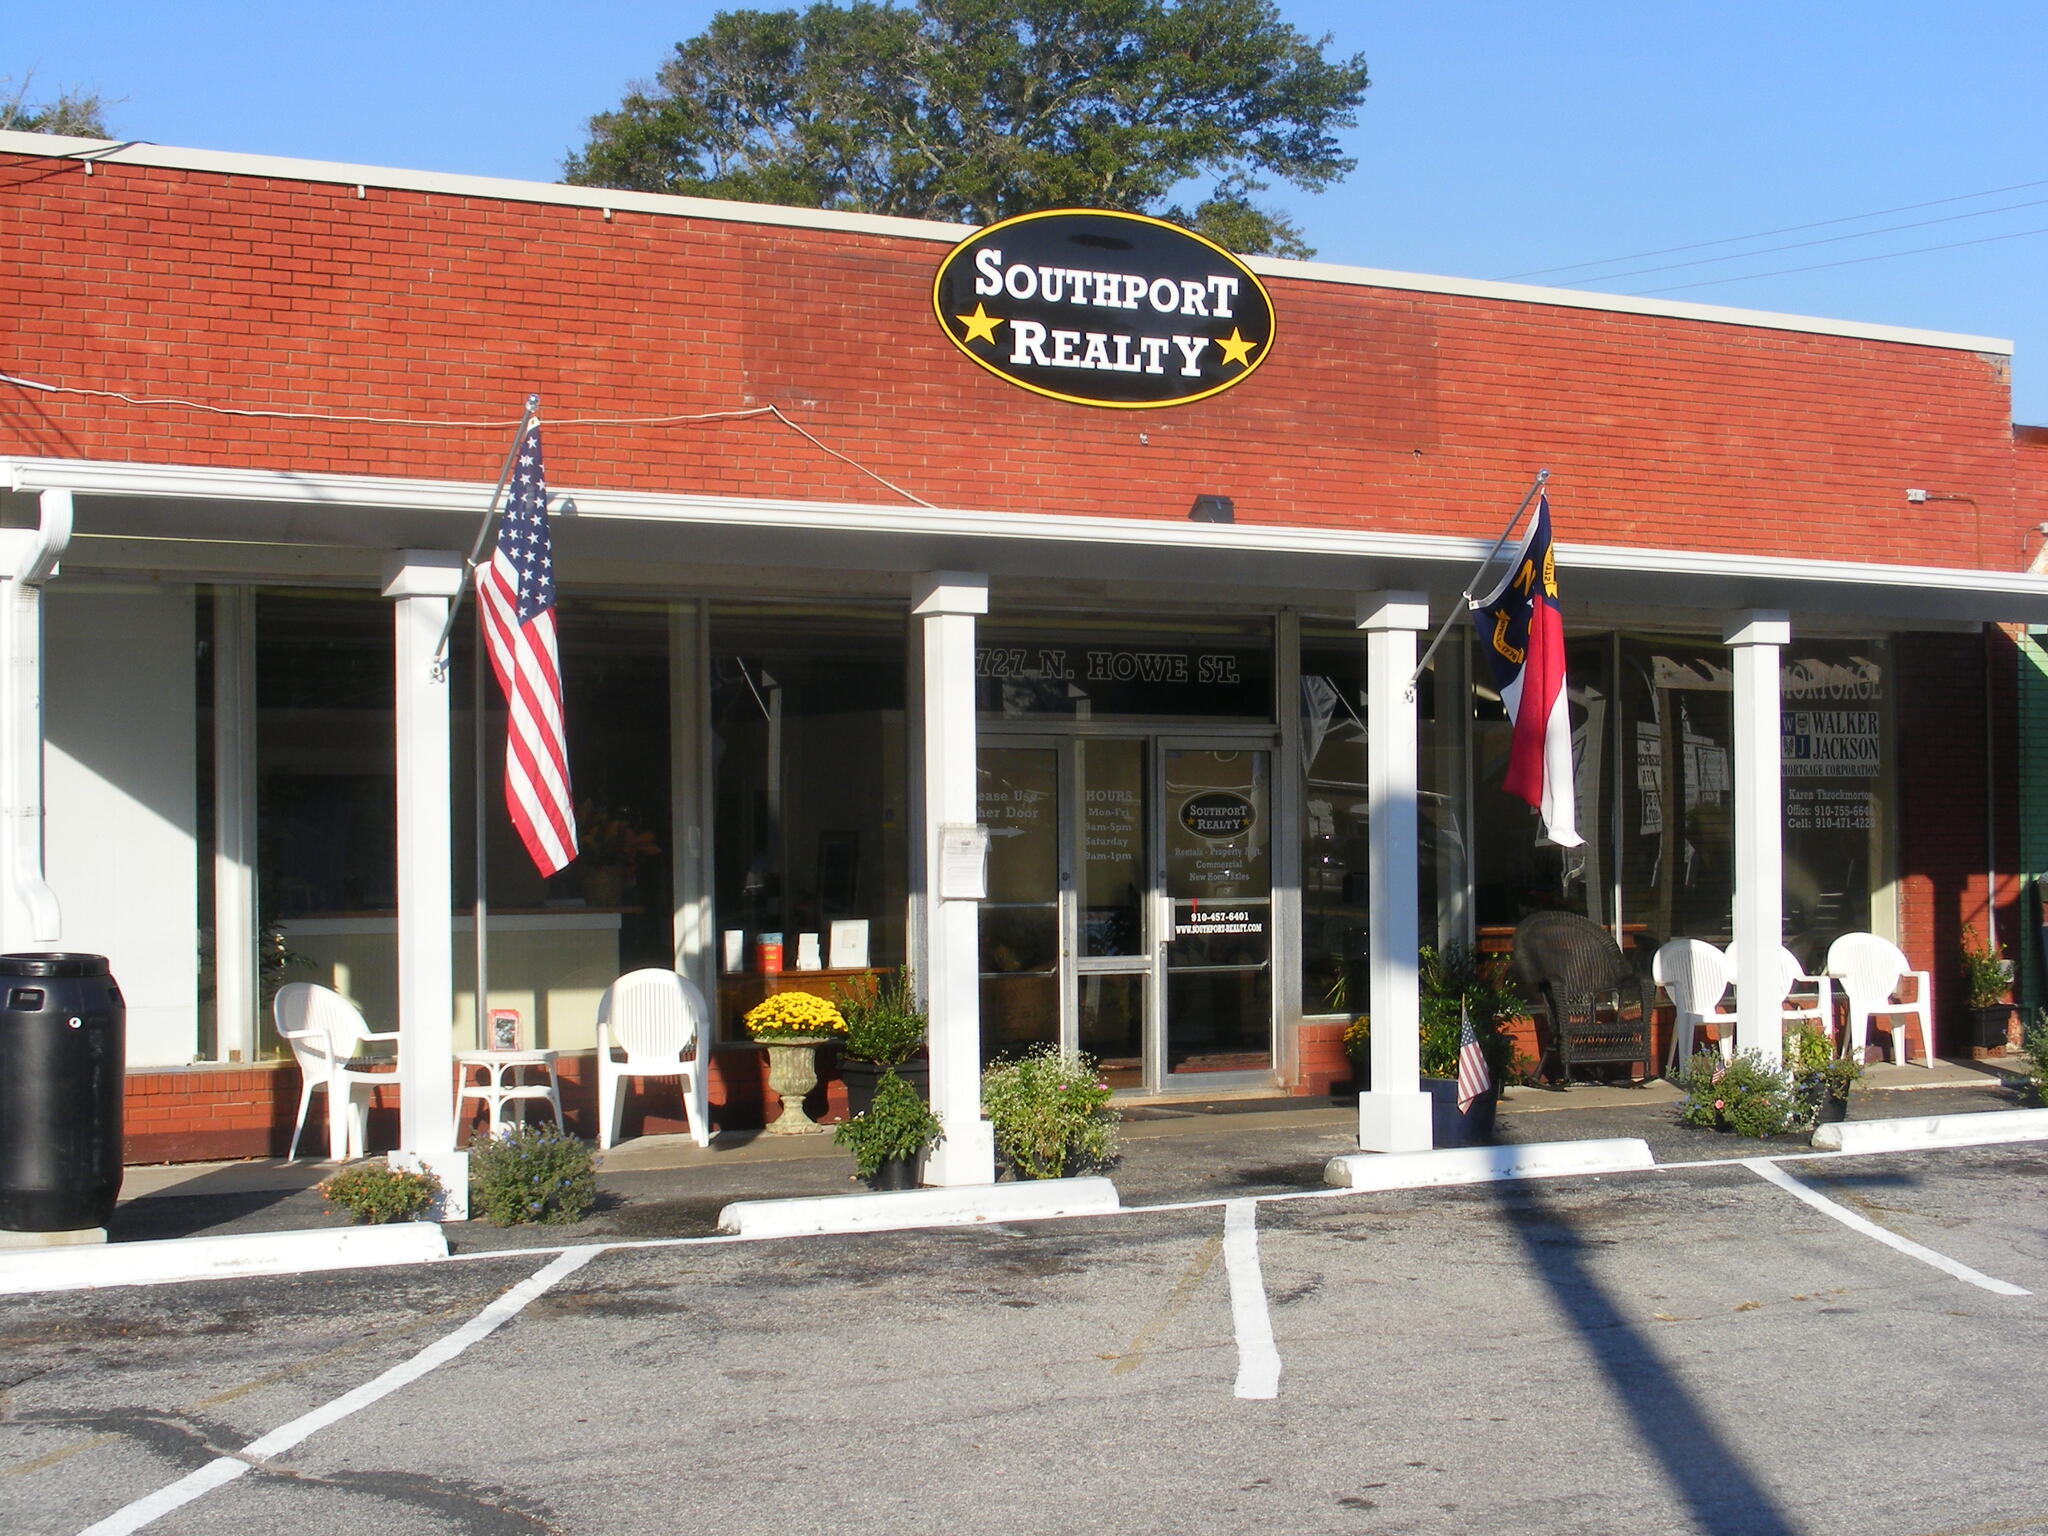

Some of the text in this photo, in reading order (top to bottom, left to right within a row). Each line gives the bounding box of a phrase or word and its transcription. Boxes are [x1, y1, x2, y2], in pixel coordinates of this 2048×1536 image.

[975, 248, 1239, 318] SOUTHPORT
[1009, 319, 1209, 377] REALTY
[976, 648, 1240, 683] 727 N. HOWE ST.
[1812, 711, 1878, 735] WALKER
[1812, 737, 1878, 760] JACKSON
[1782, 763, 1879, 776] MORTGAGE CORPORATION
[978, 792, 1008, 801] ease
[1086, 790, 1132, 801] HOURS
[1788, 789, 1814, 800] Karen
[977, 807, 1039, 818] her Door
[1088, 807, 1129, 817] Mon-Fri
[1190, 804, 1247, 816] SOUTHPORT
[1786, 804, 1812, 816] Office:
[1198, 819, 1241, 830] REALTY
[1788, 818, 1812, 829] Cell:
[1085, 837, 1128, 848] Saturday
[1196, 860, 1243, 869] Commercial
[1189, 872, 1207, 881] New
[1191, 912, 1249, 922] 910-457-6401
